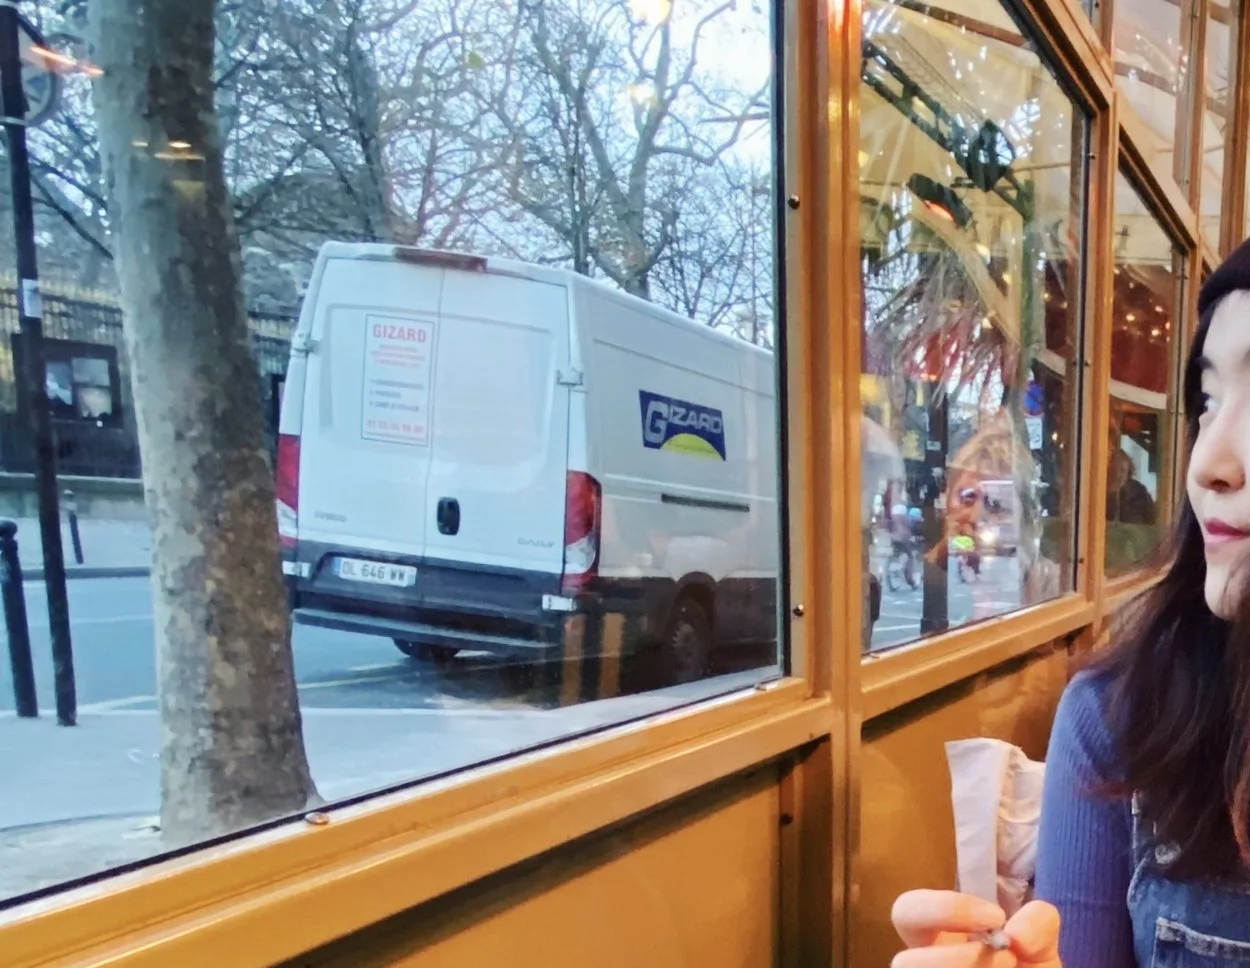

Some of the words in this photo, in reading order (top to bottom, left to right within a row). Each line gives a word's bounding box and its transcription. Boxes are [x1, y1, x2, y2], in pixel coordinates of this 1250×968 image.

[373, 323, 426, 343] GIZARD
[644, 400, 722, 443] GIZARD
[361, 563, 385, 579] 646
